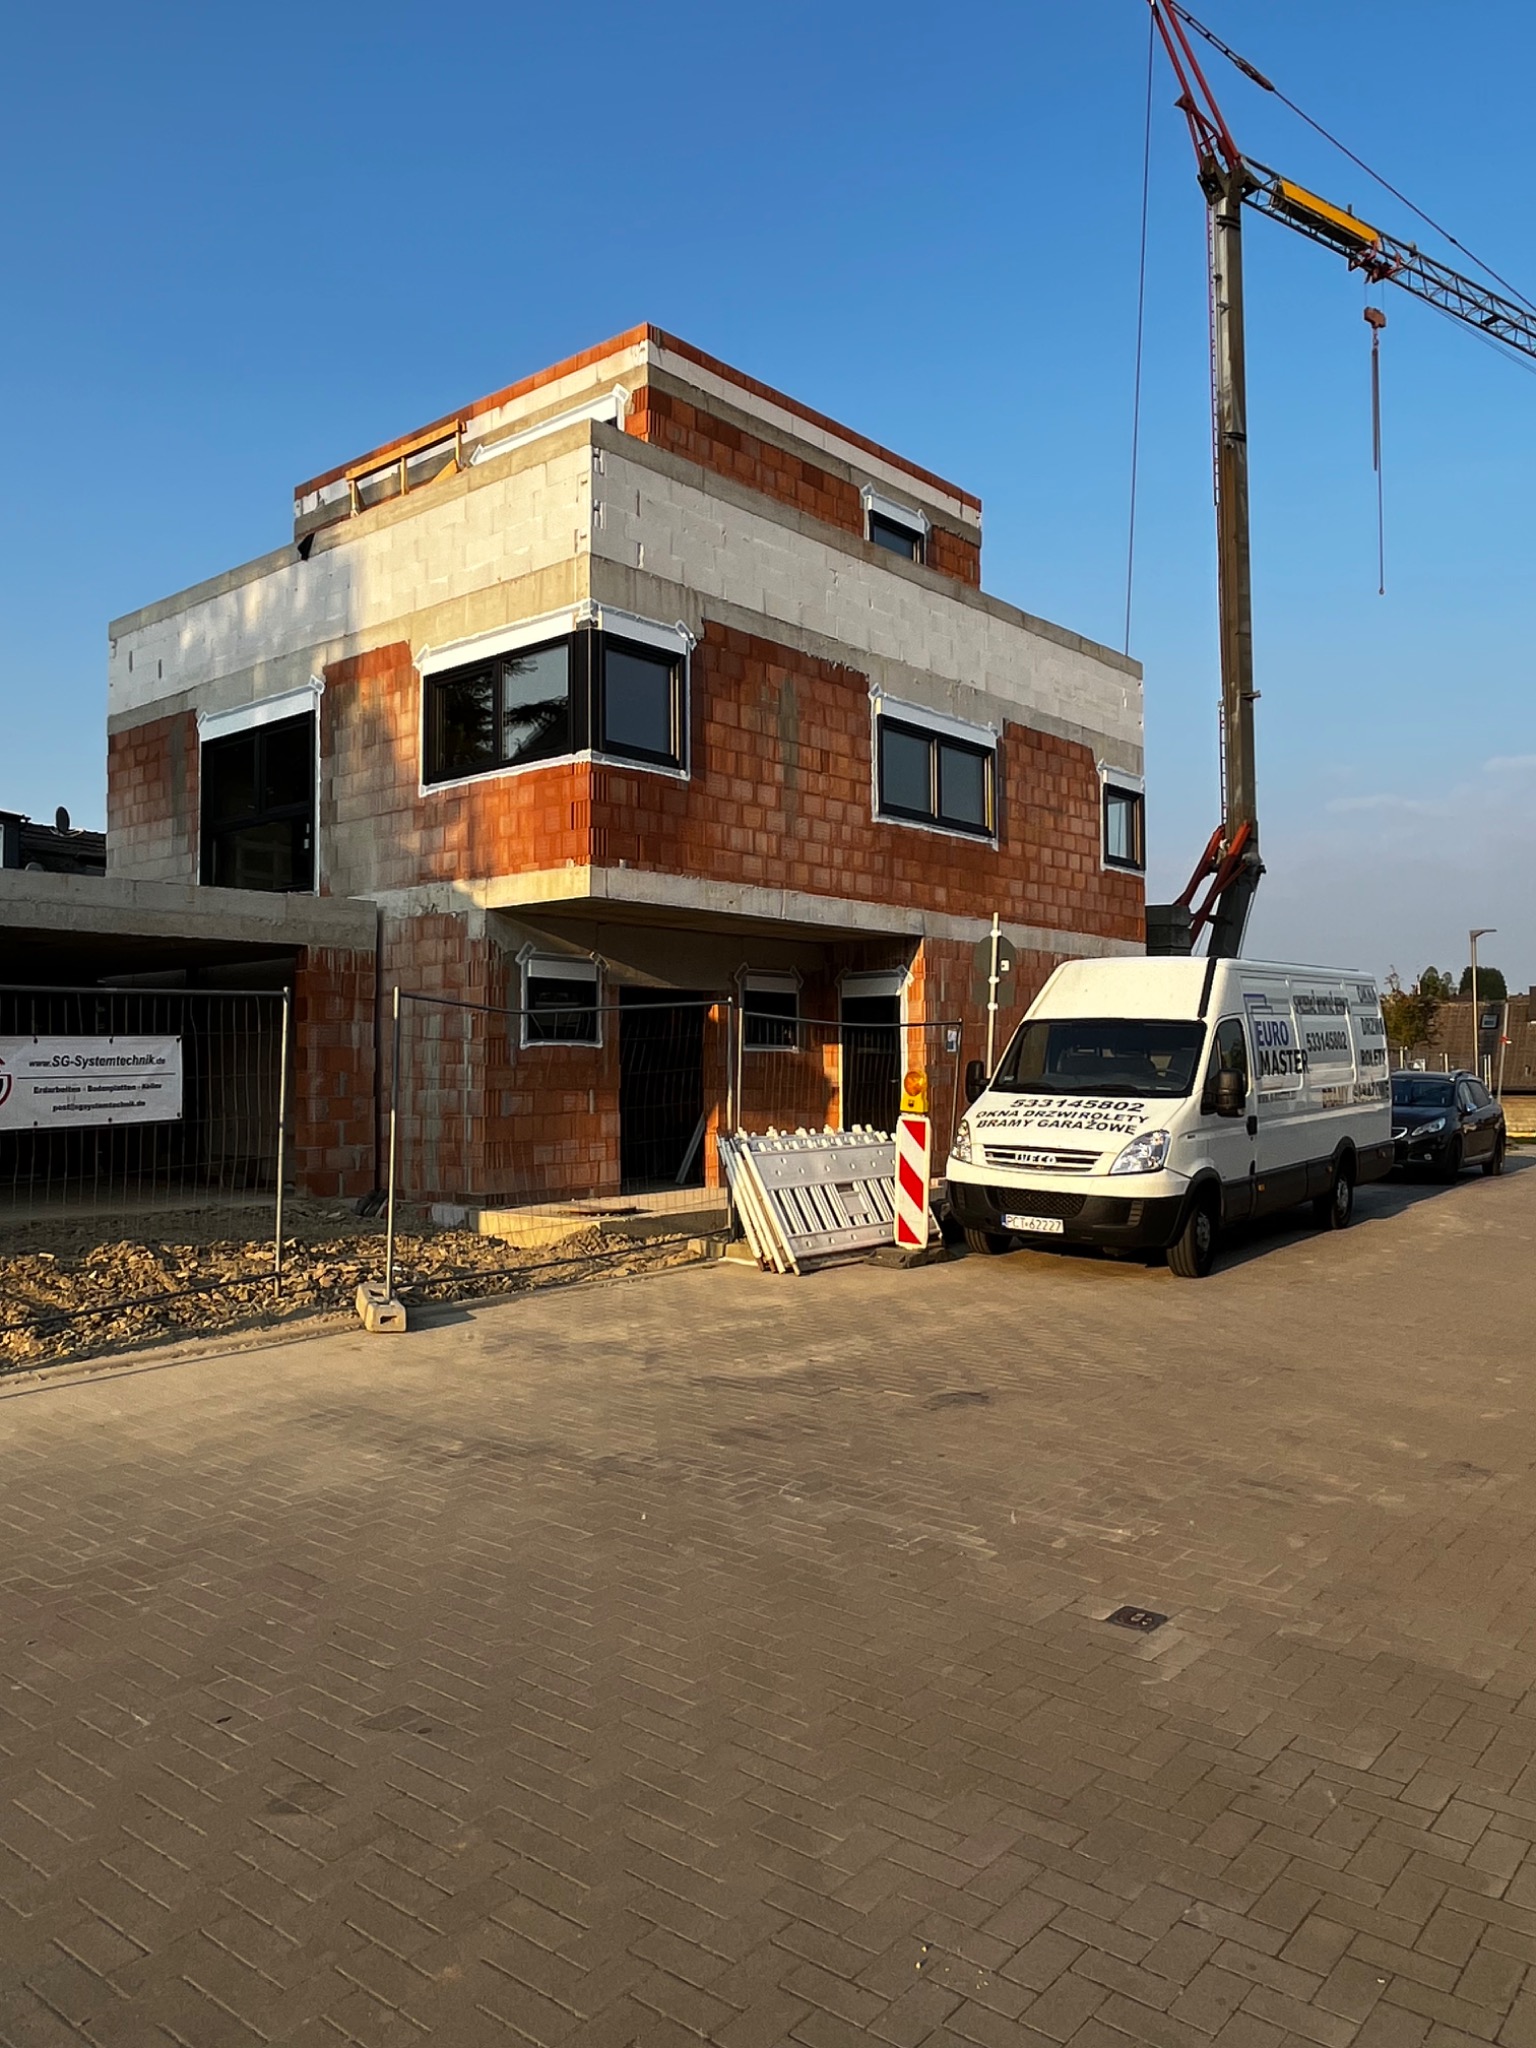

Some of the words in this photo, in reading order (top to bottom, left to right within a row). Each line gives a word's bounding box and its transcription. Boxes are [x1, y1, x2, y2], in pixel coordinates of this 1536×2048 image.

[1254, 1021, 1289, 1047] EURO
[1306, 1031, 1348, 1053] 533145802
[29, 1054, 166, 1070] www.SG-Systemtechnik.de
[1259, 1049, 1310, 1076] MASTER
[1010, 1098, 1145, 1113] 533145802
[976, 1110, 1019, 1119] OKNA
[976, 1119, 1034, 1129] BRAMY
[1037, 1119, 1138, 1136] GARAŻOWE
